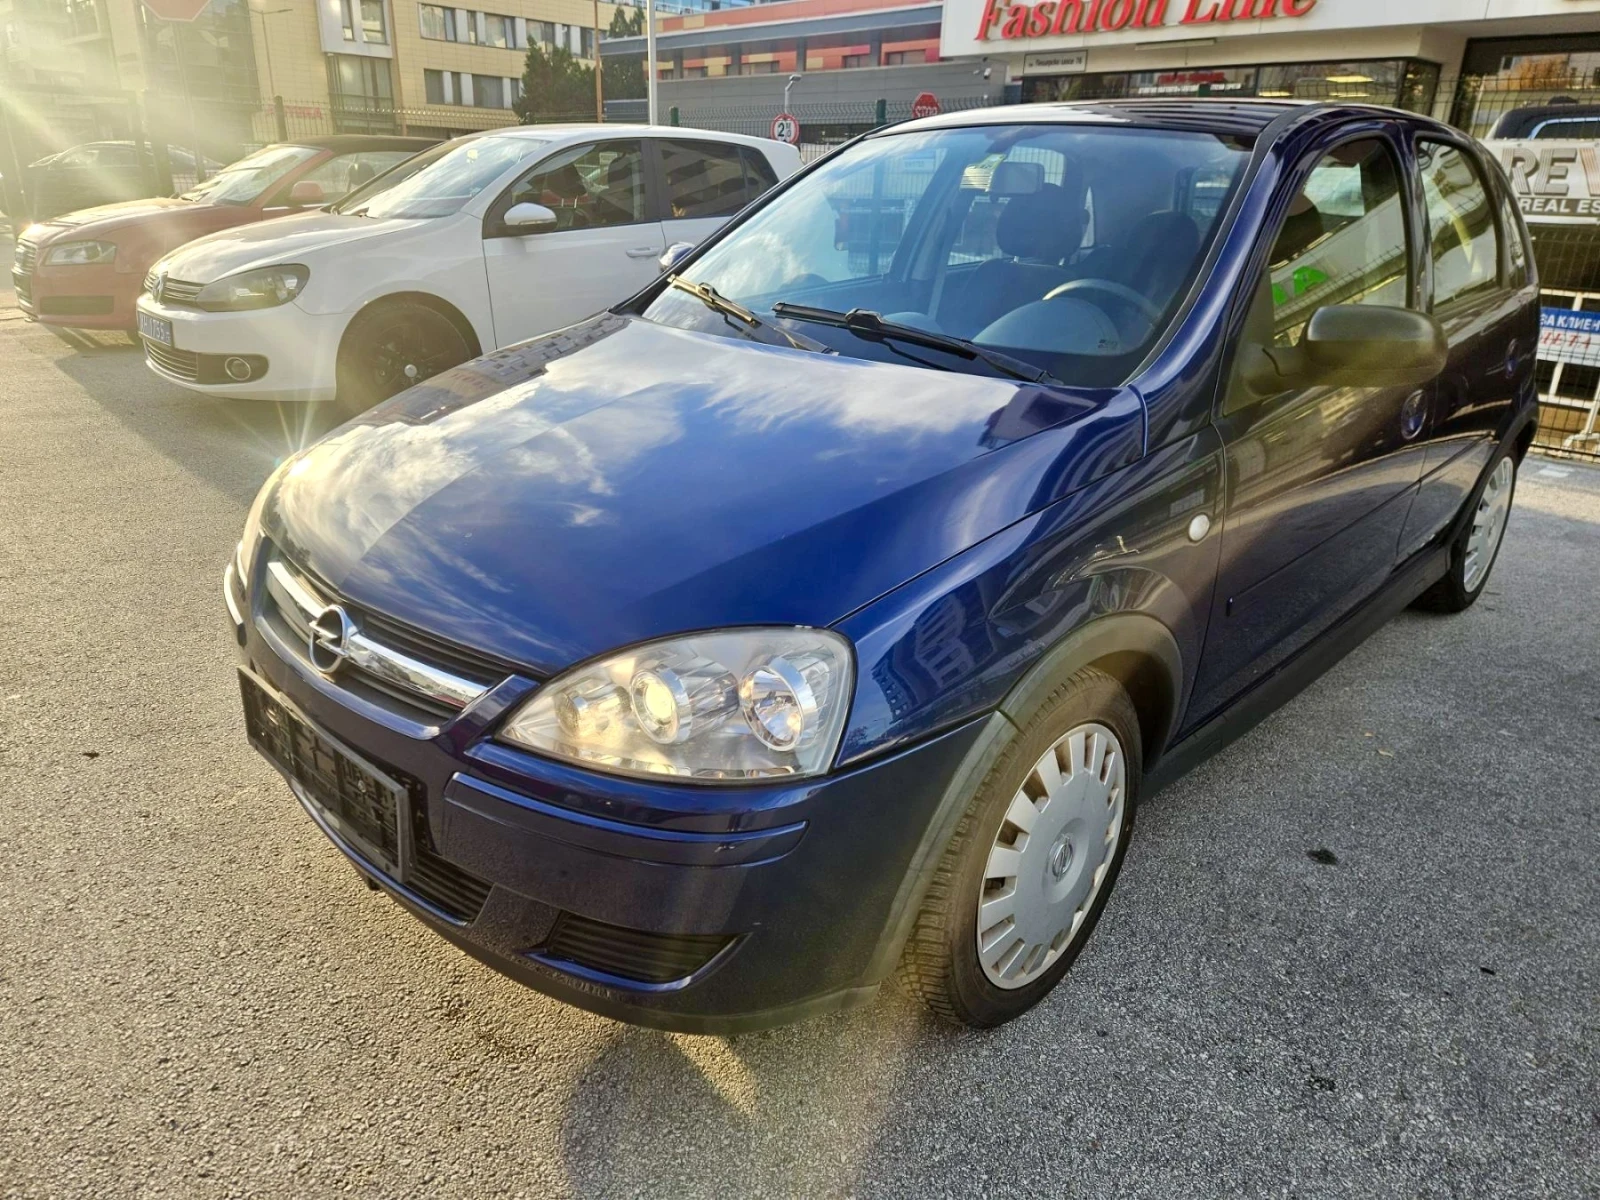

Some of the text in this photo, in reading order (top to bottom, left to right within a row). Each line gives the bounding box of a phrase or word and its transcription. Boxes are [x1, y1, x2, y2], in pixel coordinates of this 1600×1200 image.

[974, 0, 1166, 41] Fashion
[777, 122, 785, 137] 2
[1520, 198, 1570, 213] REAL
